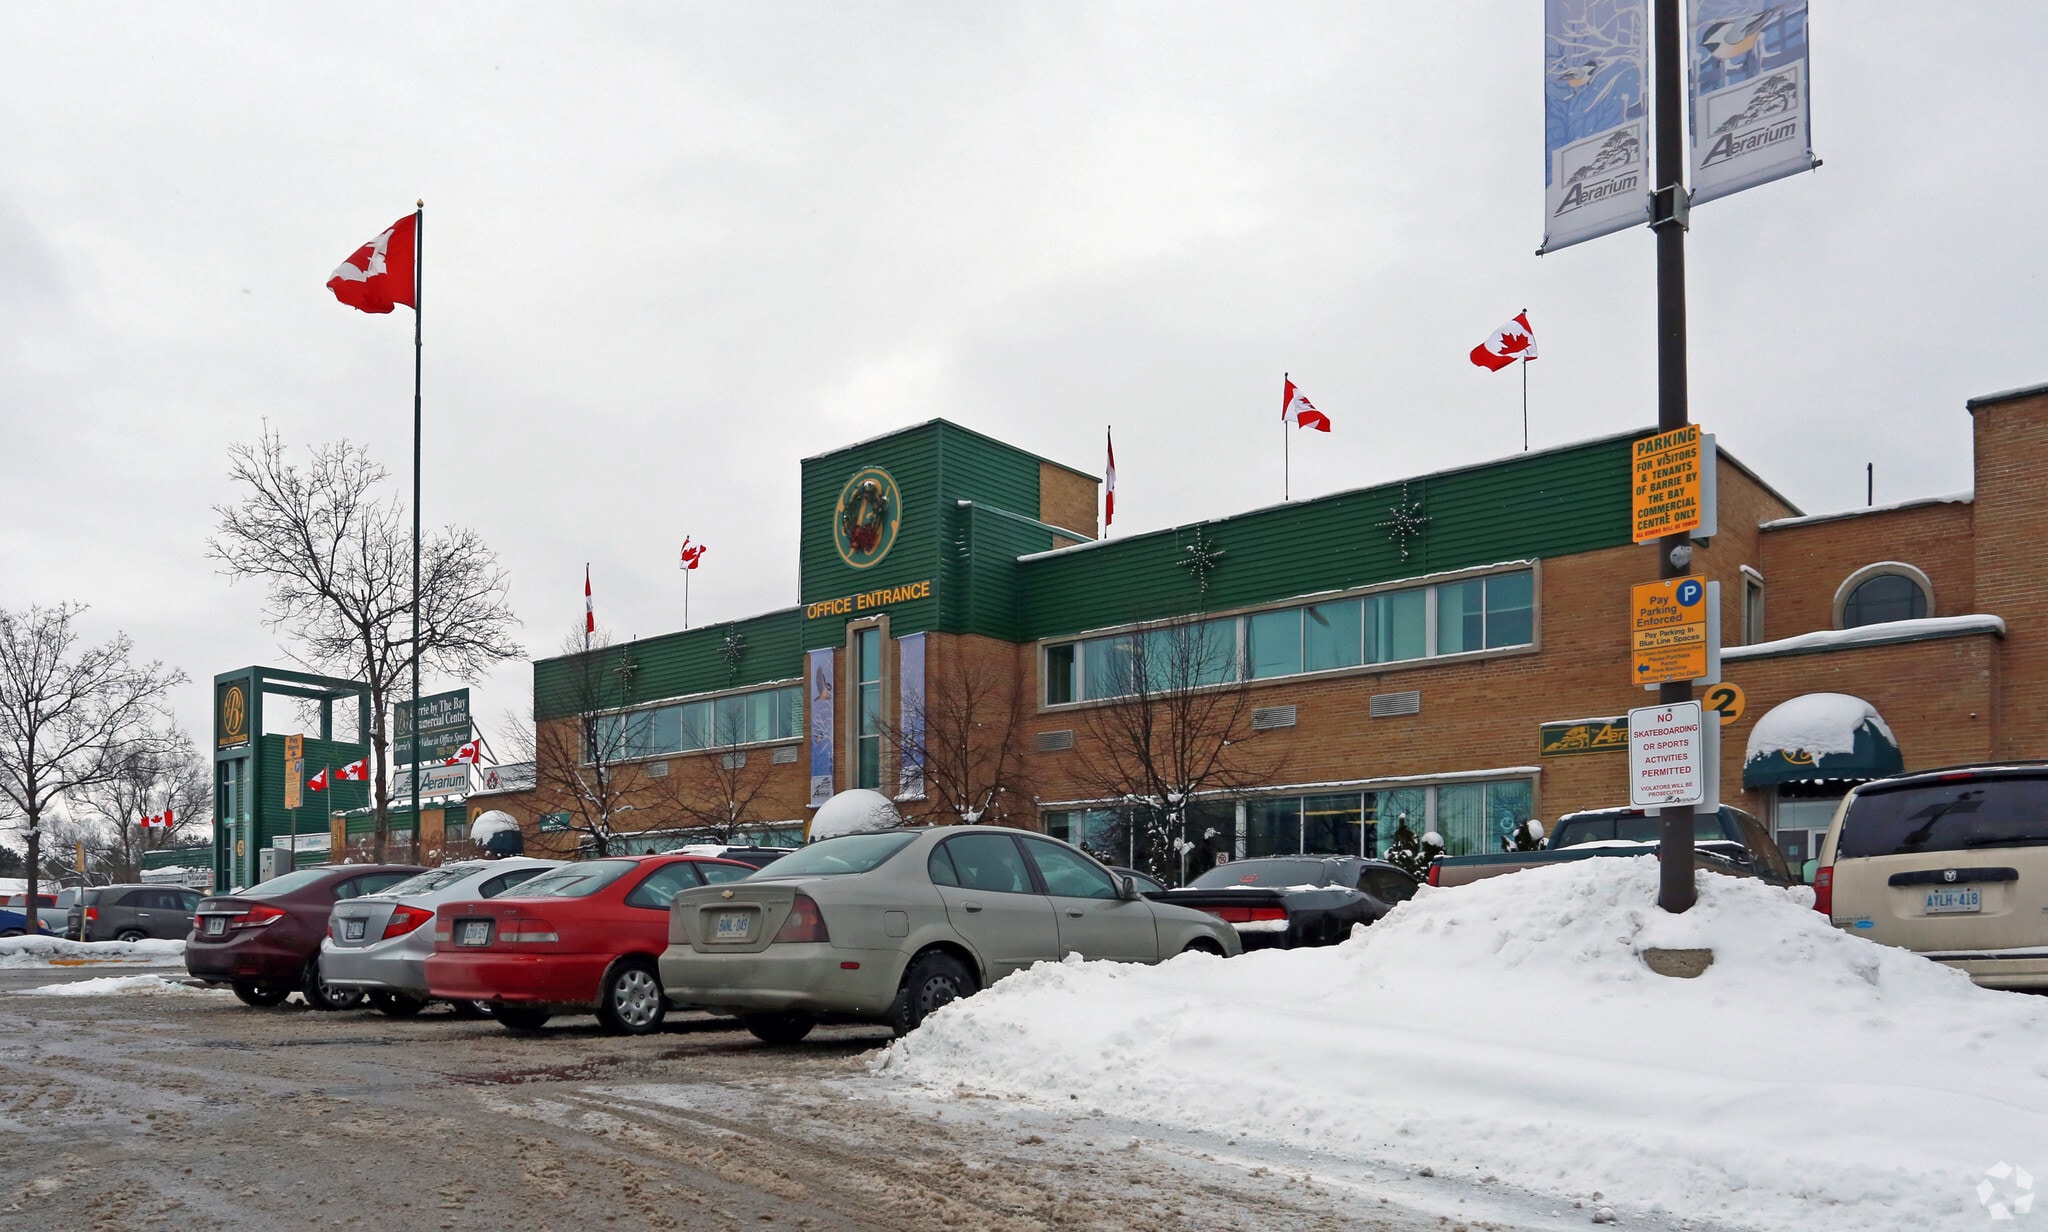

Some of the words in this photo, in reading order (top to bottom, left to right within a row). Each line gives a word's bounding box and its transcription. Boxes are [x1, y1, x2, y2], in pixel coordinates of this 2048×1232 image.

[1701, 123, 1796, 166] Aerarium
[1555, 176, 1638, 214] Aerarium
[1637, 428, 1696, 456] PARKING
[1637, 460, 1652, 472] FOR
[1657, 448, 1697, 466] VISITORS
[1642, 473, 1647, 483] &
[1652, 461, 1692, 480] TENANTS
[1636, 484, 1646, 496] OF
[1650, 476, 1682, 492] BARRIE
[1686, 472, 1697, 482] BY
[1648, 492, 1664, 505] THE
[1668, 487, 1685, 501] BAY
[1637, 497, 1696, 519] COMMERCIAL
[1637, 514, 1670, 530] CENTRE
[1674, 508, 1696, 521] ONLY
[807, 598, 851, 619] OFFICE
[857, 581, 930, 610] ENTRANCE
[1650, 596, 1668, 605] Pay
[1684, 585, 1697, 601] P
[1637, 613, 1682, 627] Enforced
[1640, 605, 1677, 617] Parking
[1645, 631, 1657, 639] Pay
[1660, 628, 1685, 637] Parking
[1656, 637, 1671, 645] Line
[1673, 634, 1700, 643] Spaces
[430, 702, 438, 717] by
[440, 699, 452, 712] The
[453, 697, 466, 711] Bay
[1711, 689, 1737, 717] 2
[410, 713, 444, 731] Cmmercial
[445, 712, 467, 725] Centre
[1657, 713, 1673, 723] NO
[1591, 724, 1629, 745] Aera
[1633, 724, 1698, 738] SKATEBOARDING
[1643, 742, 1656, 751] OR
[1657, 739, 1689, 750] SPORTS
[1645, 753, 1688, 764] ACTIVITIES
[1642, 766, 1692, 778] PERMITTED
[420, 772, 465, 792] Aerarium
[1641, 783, 1671, 791] VIOLATORS
[1927, 892, 1978, 907] AYLH-418
